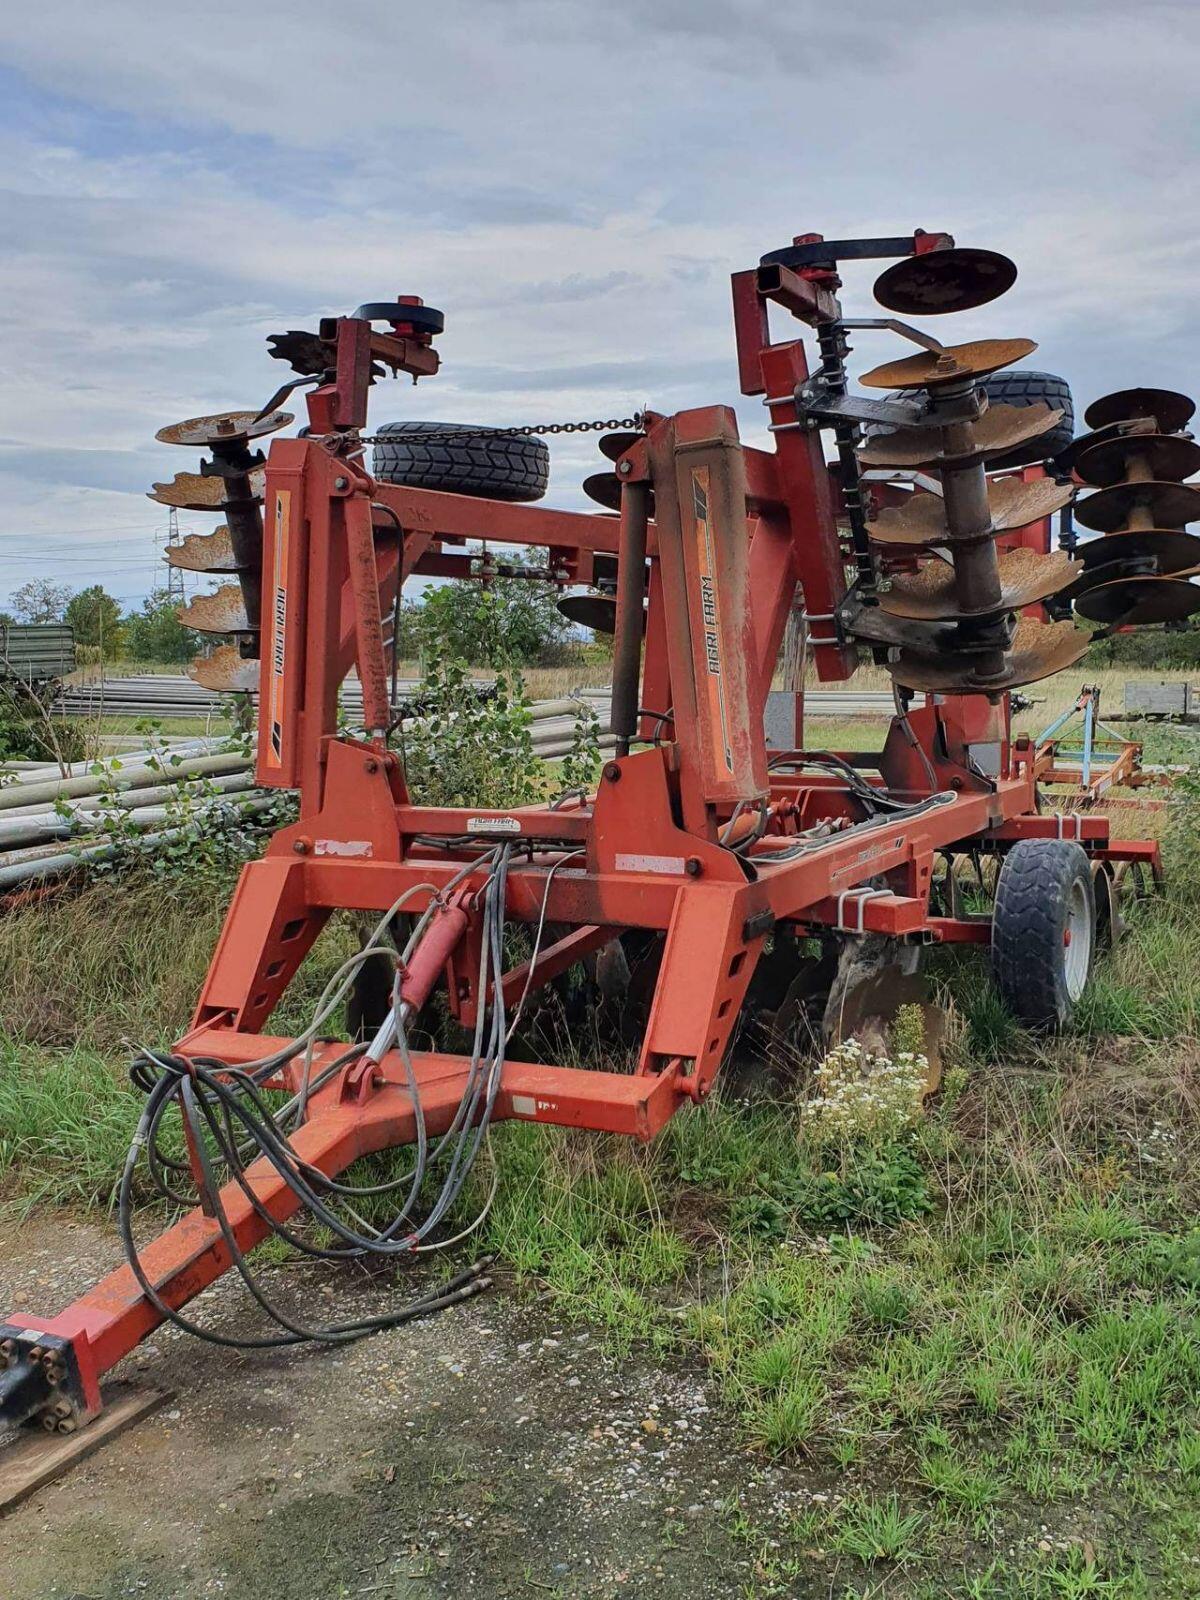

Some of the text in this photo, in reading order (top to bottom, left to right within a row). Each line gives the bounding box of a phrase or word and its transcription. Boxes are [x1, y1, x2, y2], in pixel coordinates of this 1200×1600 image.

[276, 587, 286, 626] AGRI
[701, 575, 719, 674] AGRI FARM
